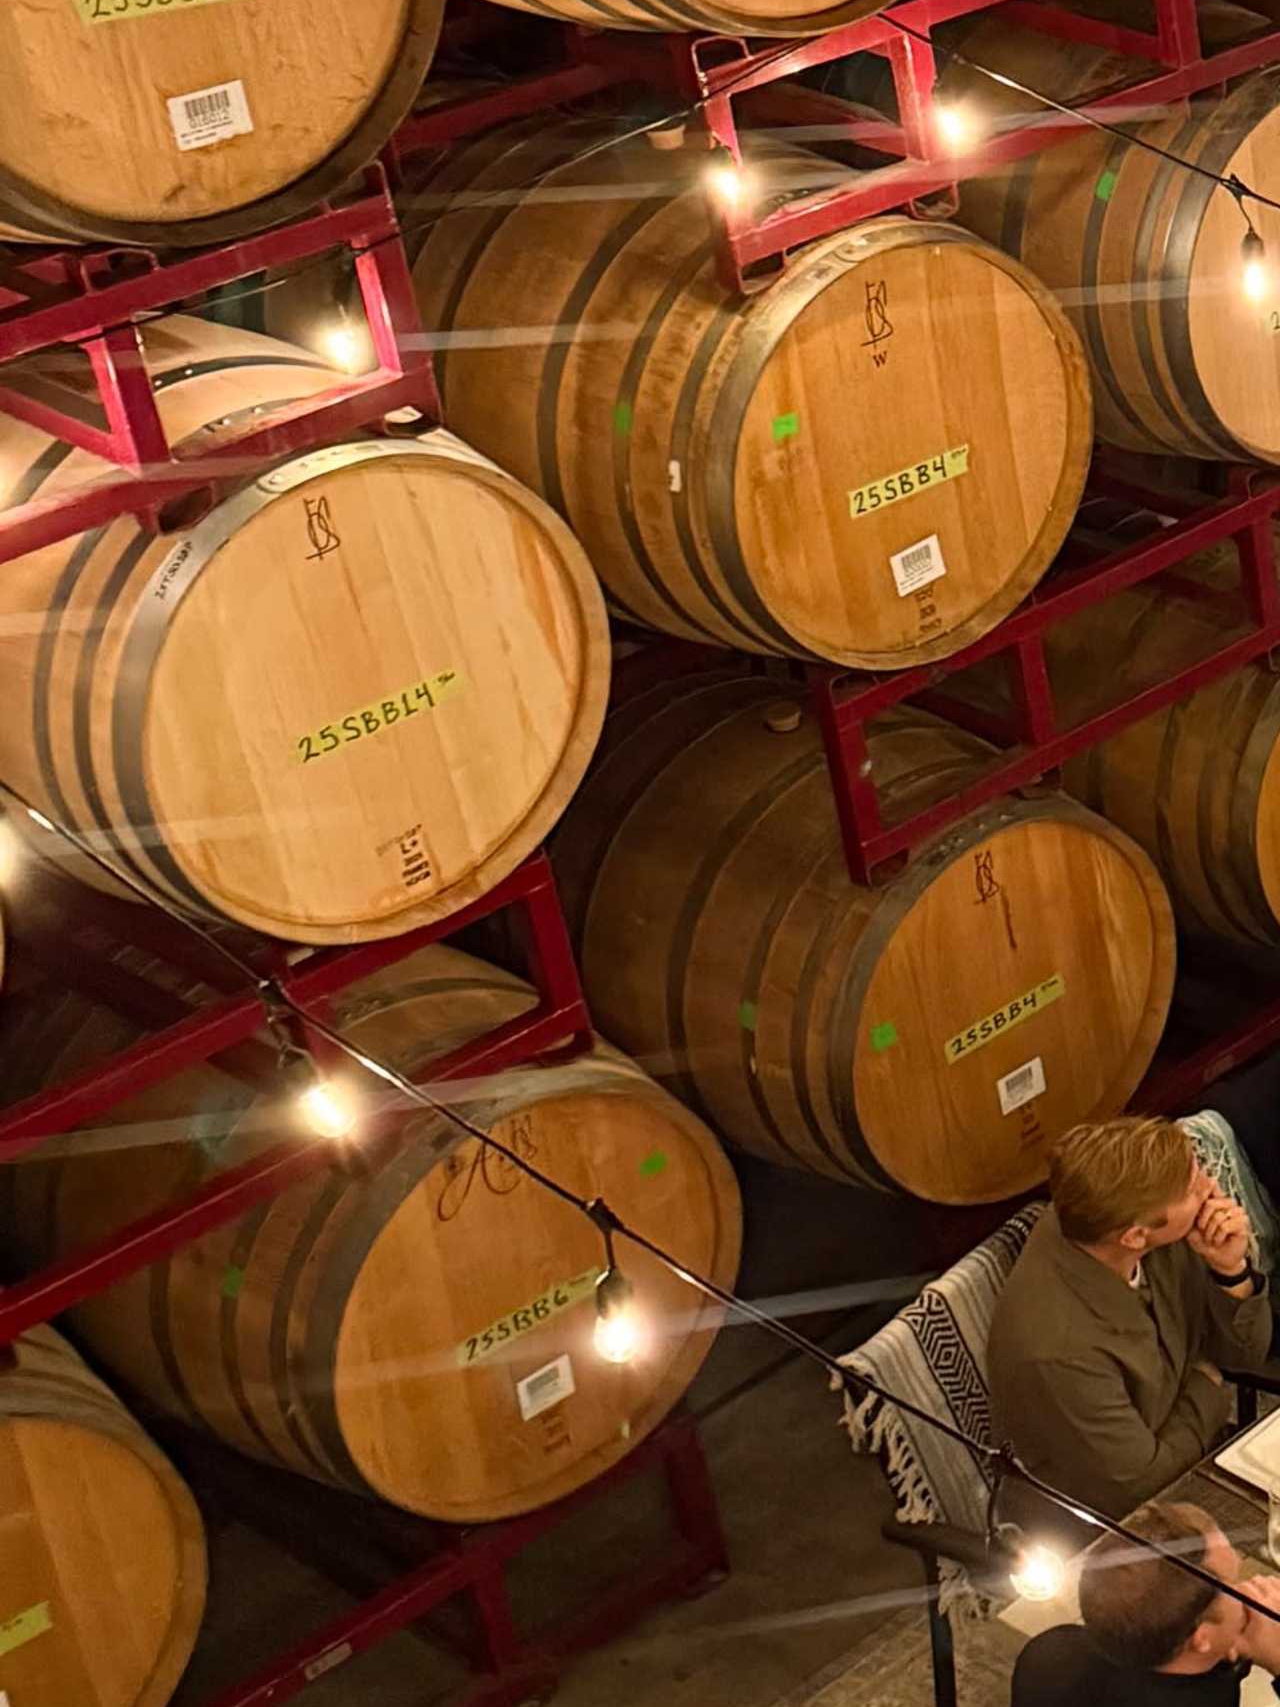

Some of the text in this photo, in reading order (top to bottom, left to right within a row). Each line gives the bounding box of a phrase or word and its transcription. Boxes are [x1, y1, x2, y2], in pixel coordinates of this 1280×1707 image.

[853, 454, 948, 515] 25SBB4
[298, 682, 436, 764] 25SBB14
[950, 993, 1038, 1055] 25SBB4
[466, 1289, 569, 1360] 25SBB6
